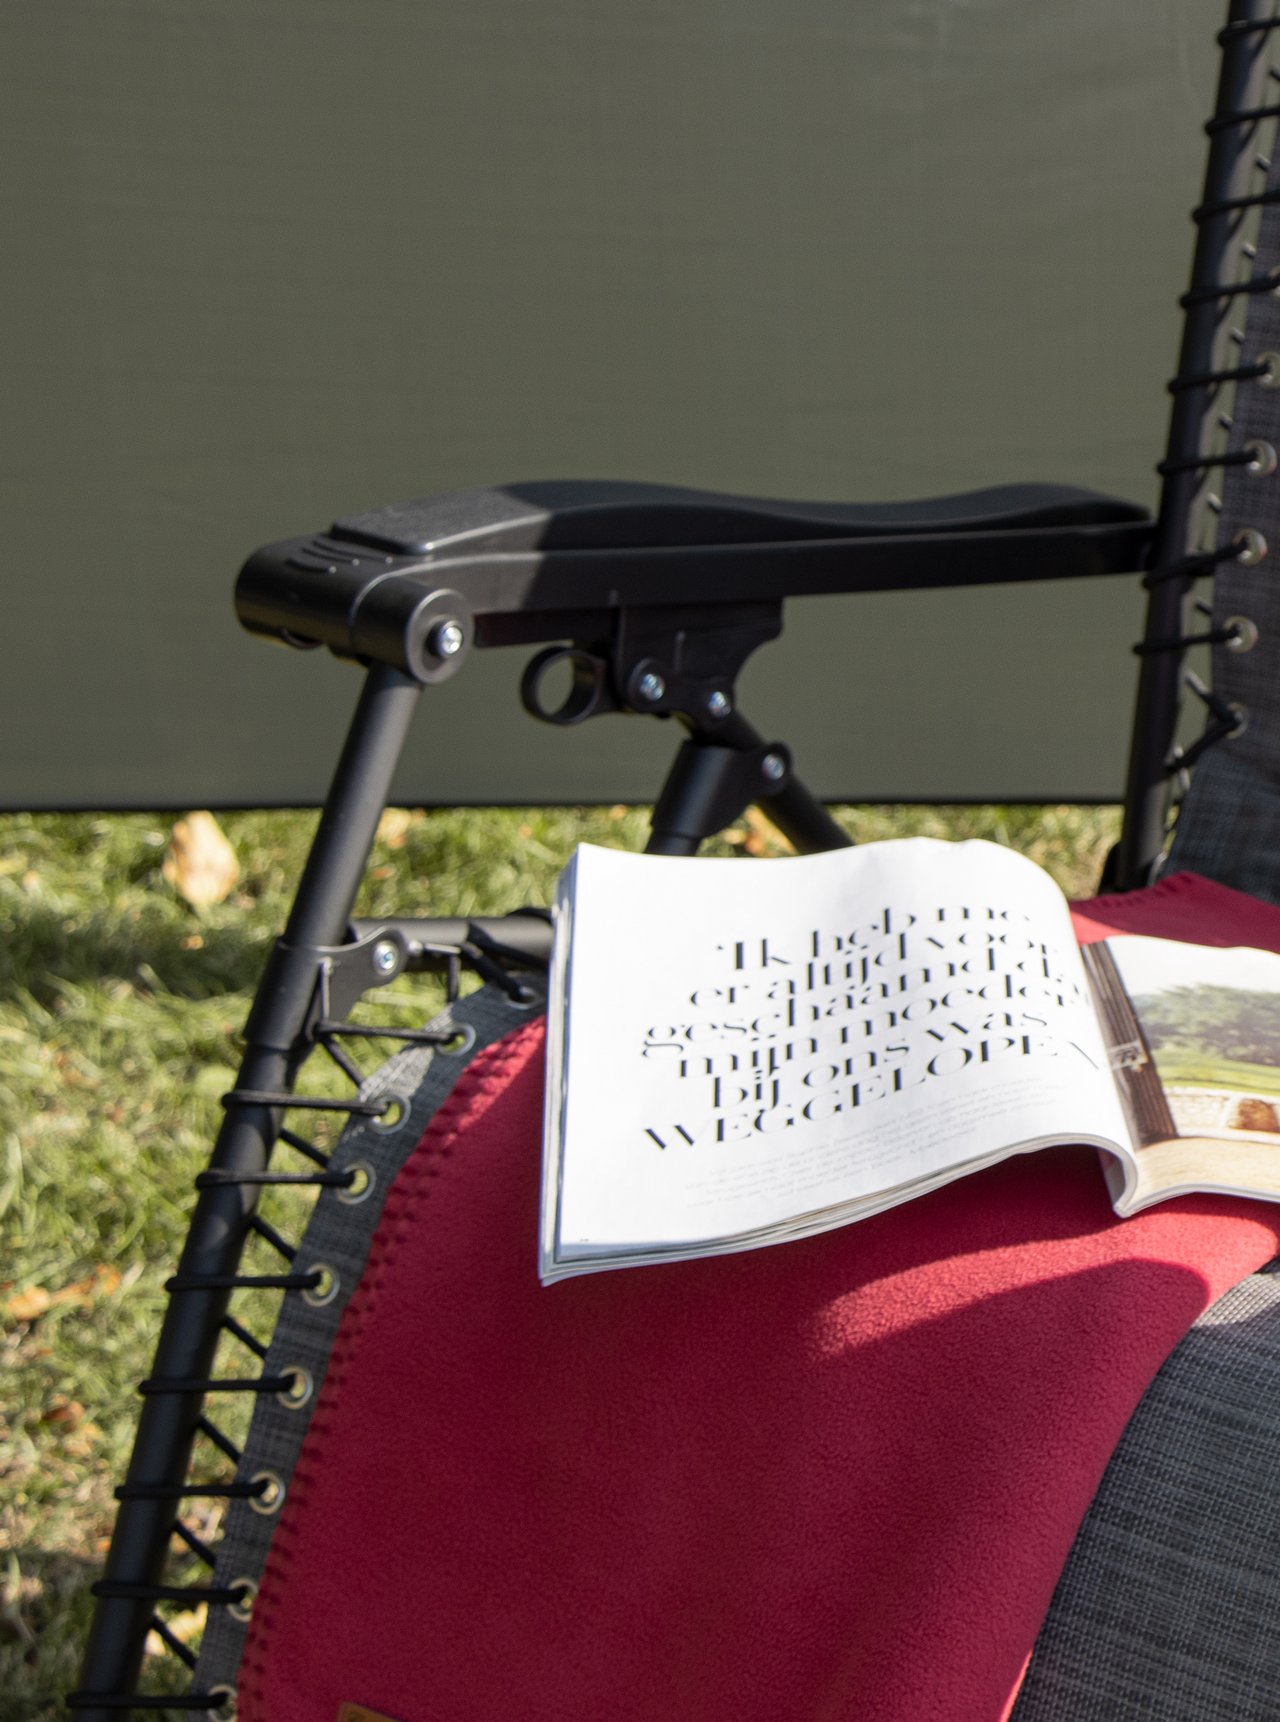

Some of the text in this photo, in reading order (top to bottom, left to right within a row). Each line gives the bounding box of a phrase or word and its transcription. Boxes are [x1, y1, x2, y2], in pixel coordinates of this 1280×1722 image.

[689, 984, 751, 1008] er
[766, 931, 907, 999] altijd
[811, 907, 918, 960] heb
[640, 947, 995, 1058] geschaamd
[679, 973, 1075, 1078] mijn moeder
[642, 1034, 1100, 1151] WEGGELOPEN
[711, 1010, 1049, 1113] bij ons was
